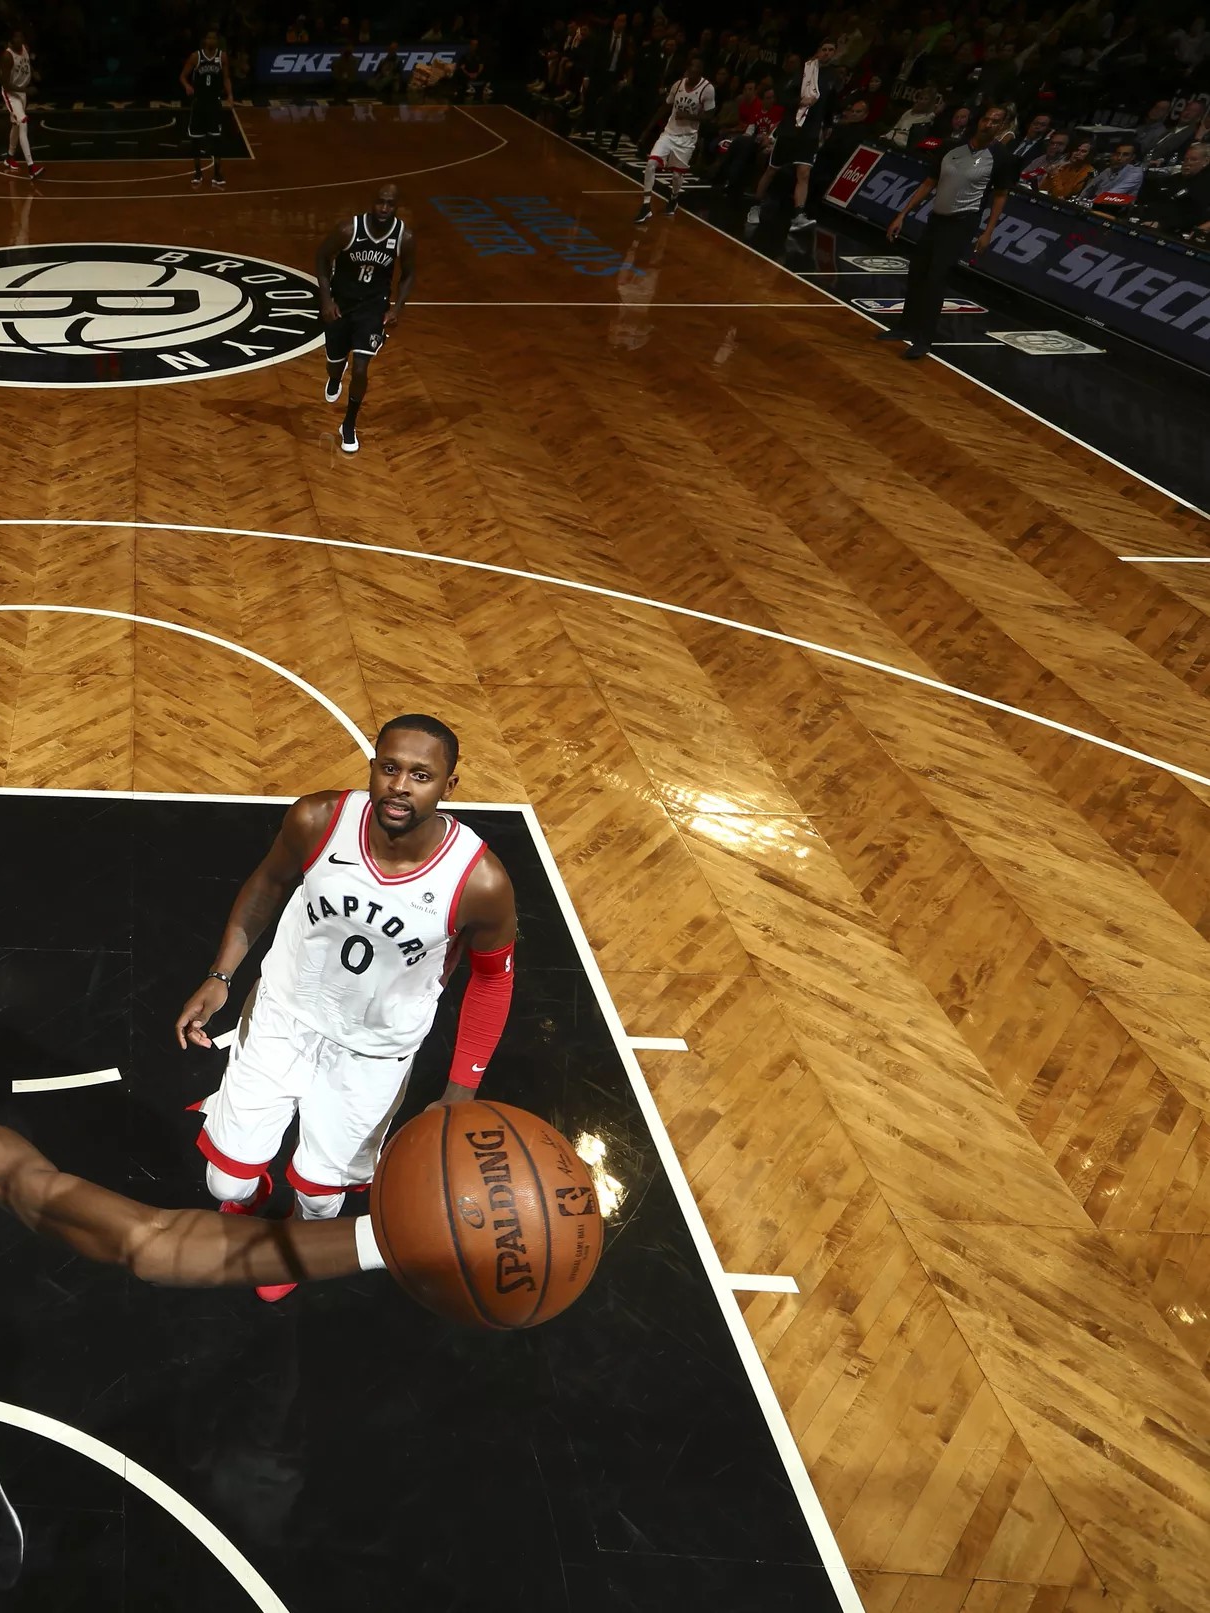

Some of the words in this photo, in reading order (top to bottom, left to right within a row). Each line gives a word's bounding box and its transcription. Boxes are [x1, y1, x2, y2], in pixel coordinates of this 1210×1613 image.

[270, 51, 456, 73] SKEHRS
[842, 165, 864, 184] infor
[349, 249, 394, 267] BROOKLYN
[357, 263, 375, 283] 13
[153, 251, 320, 371] BROOKLYN
[409, 900, 424, 912] Sun
[424, 905, 437, 916] Life
[306, 895, 428, 967] RAPTORS
[340, 934, 374, 975] 0
[465, 1129, 537, 1295] SPALDING
